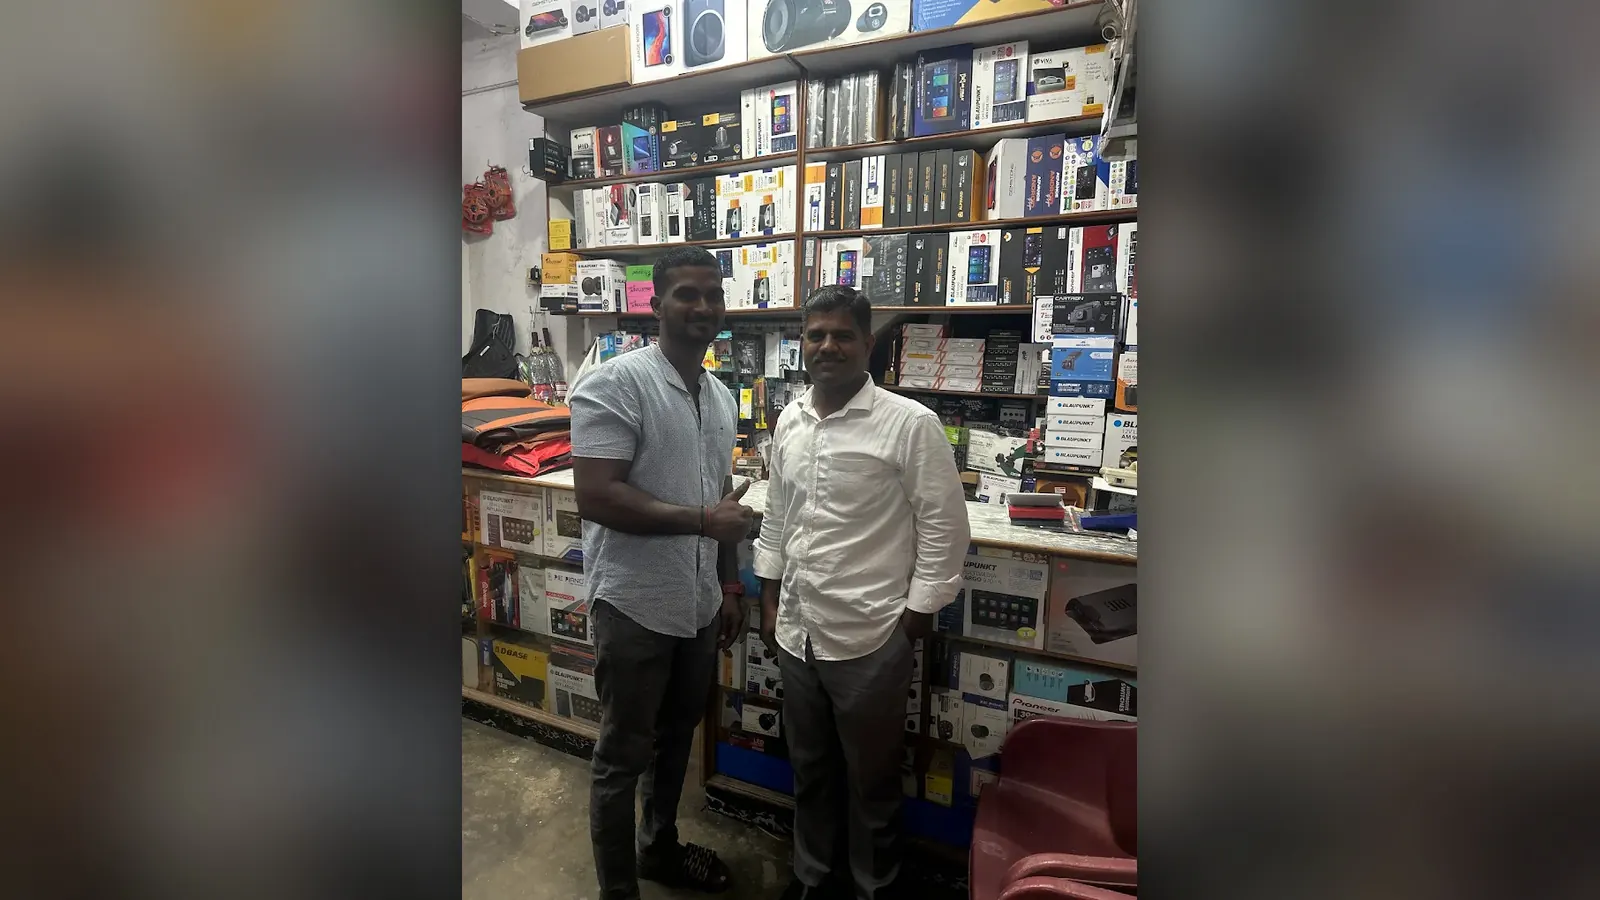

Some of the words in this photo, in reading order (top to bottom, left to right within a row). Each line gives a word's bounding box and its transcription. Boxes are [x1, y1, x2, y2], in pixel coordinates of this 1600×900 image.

[487, 496, 514, 504] BLAUPUNKT
[1104, 598, 1132, 612] JBL
[500, 648, 528, 660] DBASE
[555, 670, 583, 682] BLAUPUNKT
[1118, 682, 1127, 712] SWITCHES
[1012, 698, 1060, 712] Pioneer
